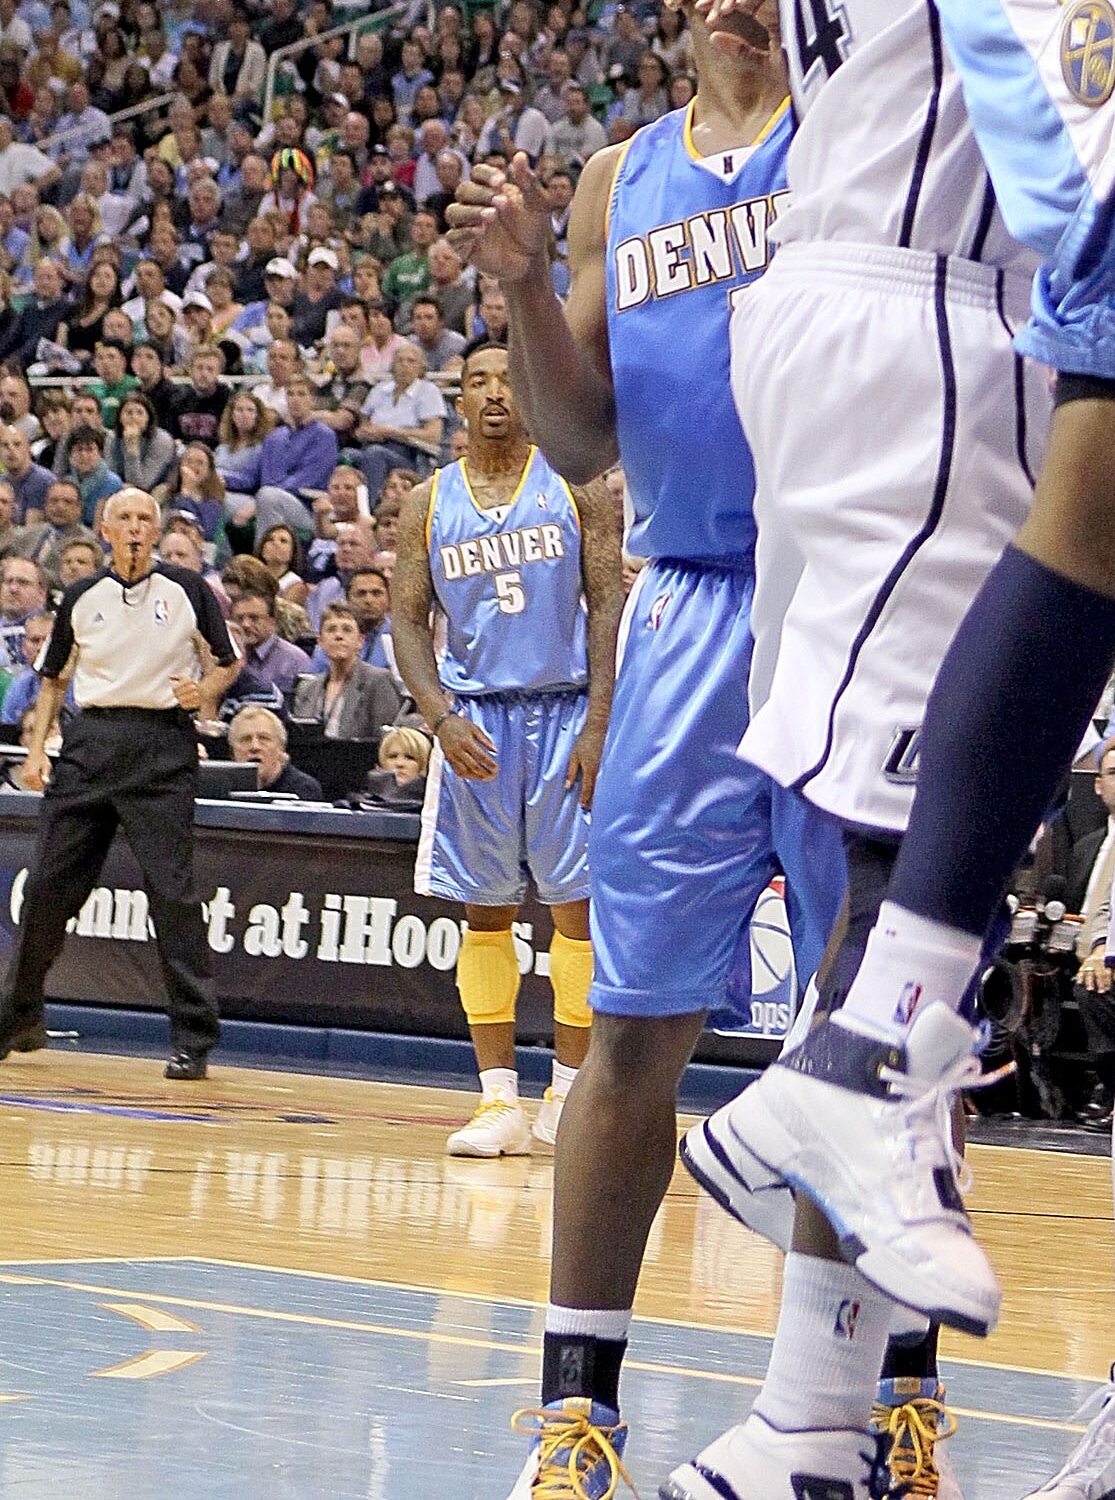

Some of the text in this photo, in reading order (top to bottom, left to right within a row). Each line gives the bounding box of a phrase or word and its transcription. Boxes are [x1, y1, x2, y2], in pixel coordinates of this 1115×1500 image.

[614, 189, 793, 314] DENV
[439, 523, 564, 581] DENVER
[494, 570, 527, 616] 5
[243, 891, 310, 959] at
